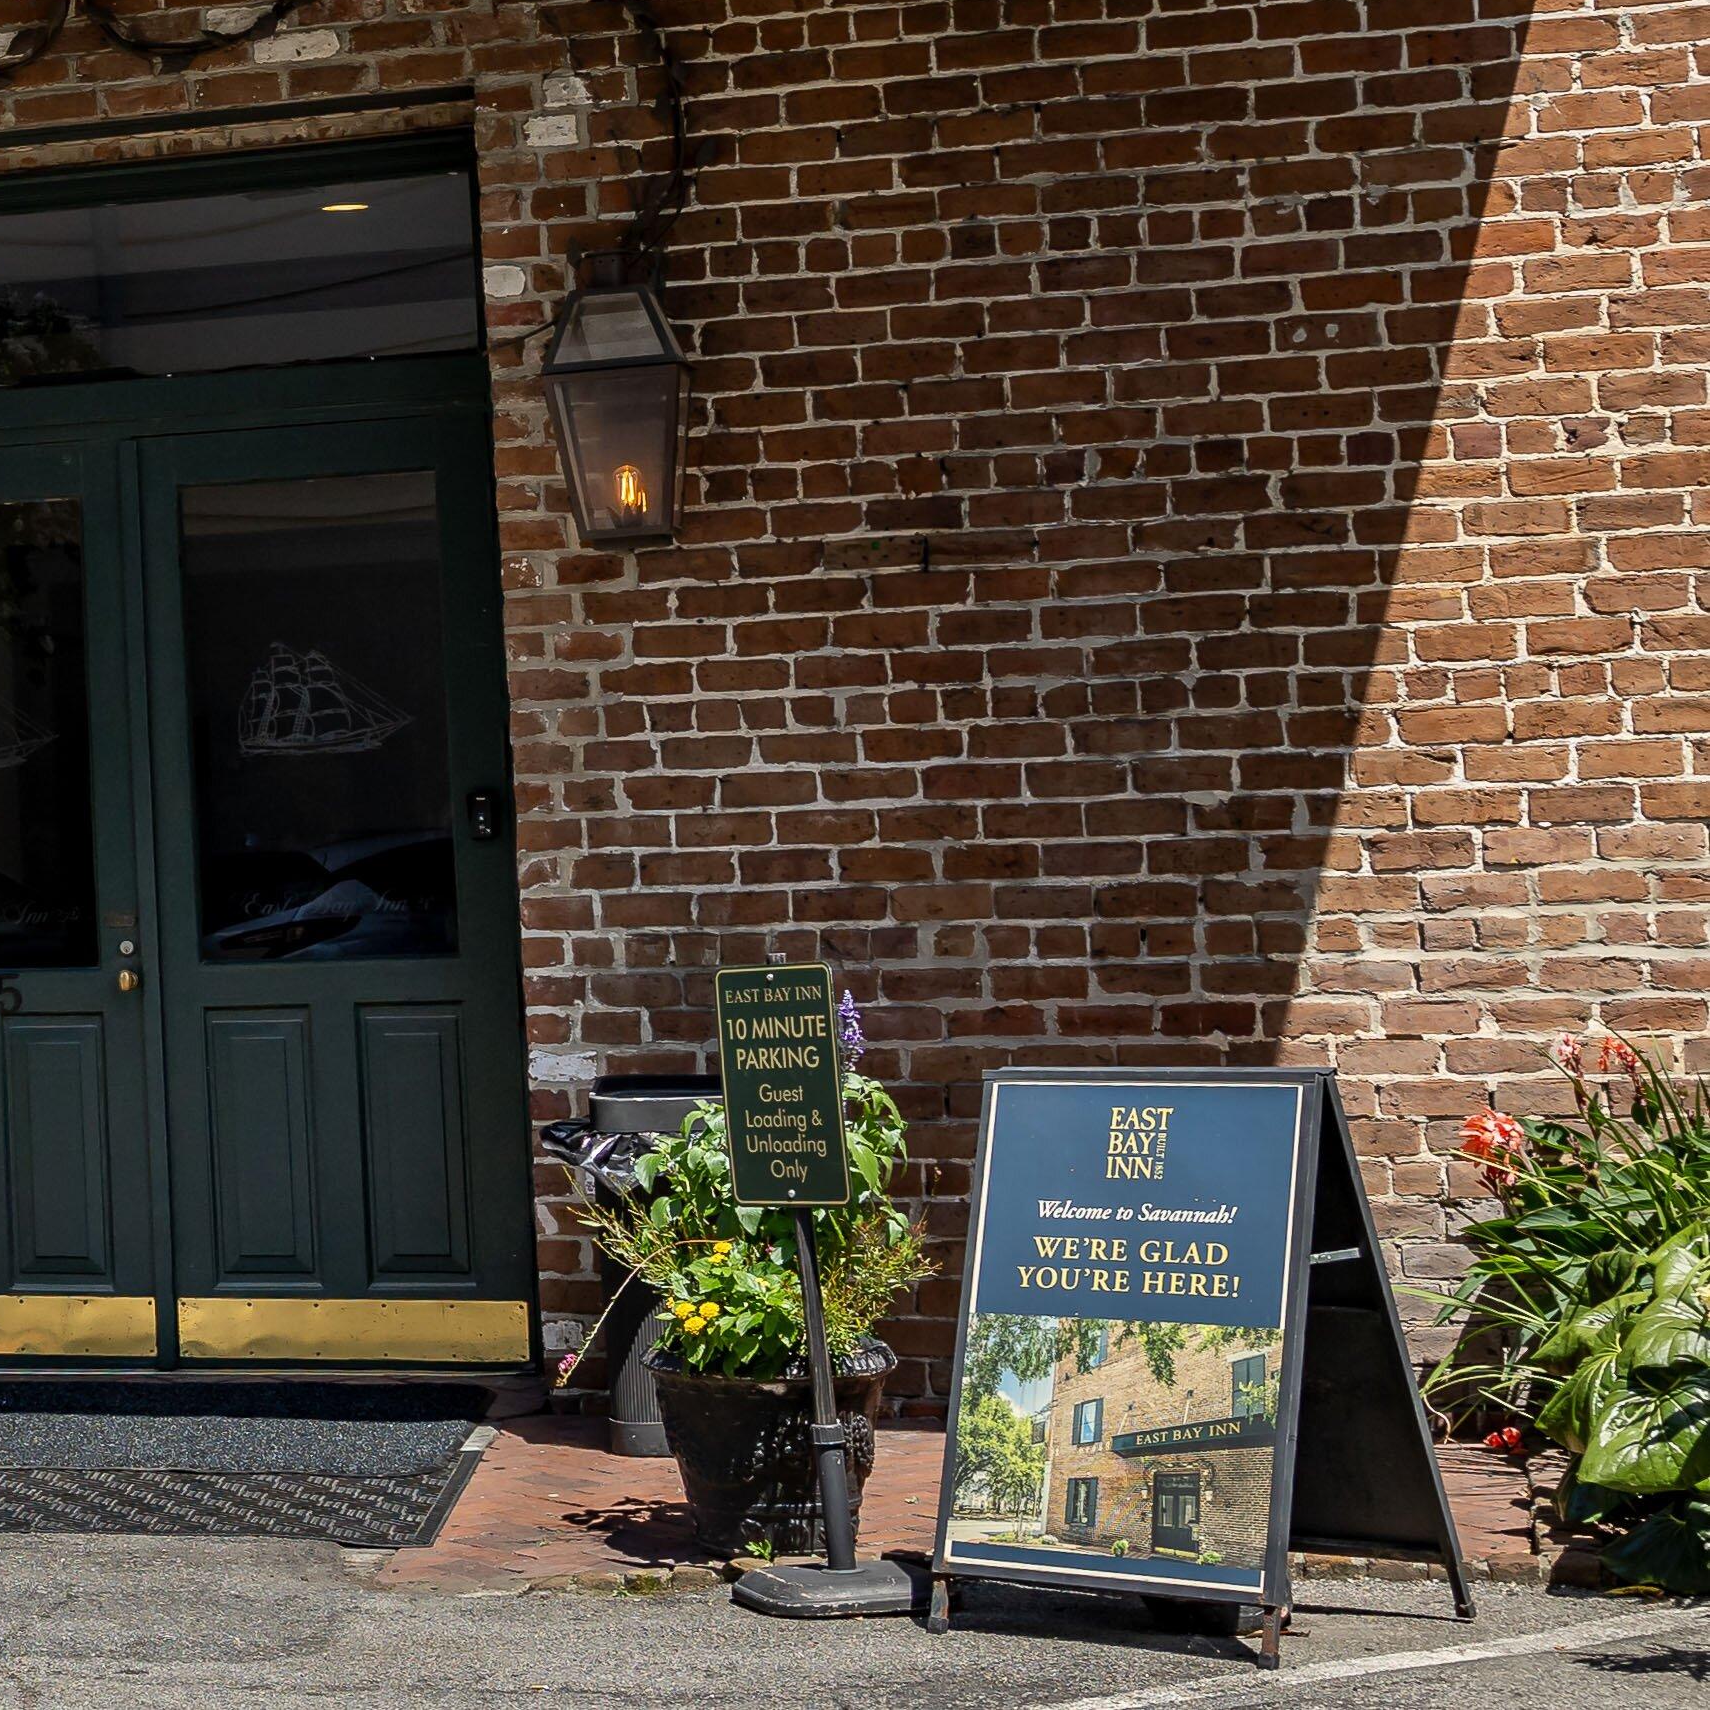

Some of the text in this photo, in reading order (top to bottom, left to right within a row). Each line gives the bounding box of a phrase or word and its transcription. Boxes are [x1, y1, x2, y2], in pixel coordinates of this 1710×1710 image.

[725, 985, 822, 1004] EAST BAY INN
[726, 1014, 827, 1040] 10 MINUTE
[736, 1045, 820, 1070] PARKING
[759, 1083, 803, 1103] Guest
[745, 1108, 823, 1132] Loading &
[1109, 1106, 1175, 1131] EAST
[745, 1133, 827, 1158] Unloading
[1107, 1131, 1157, 1155] BAY
[1155, 1132, 1167, 1159] BUILT
[770, 1158, 808, 1183] Only
[1105, 1156, 1154, 1180] INN
[1037, 1199, 1239, 1224] Welcome to Savannah!
[1033, 1236, 1229, 1265] WE'RE GLAD
[1017, 1265, 1241, 1299] YOU'RE HERE!
[1136, 1421, 1241, 1446] EAST BAY INN
